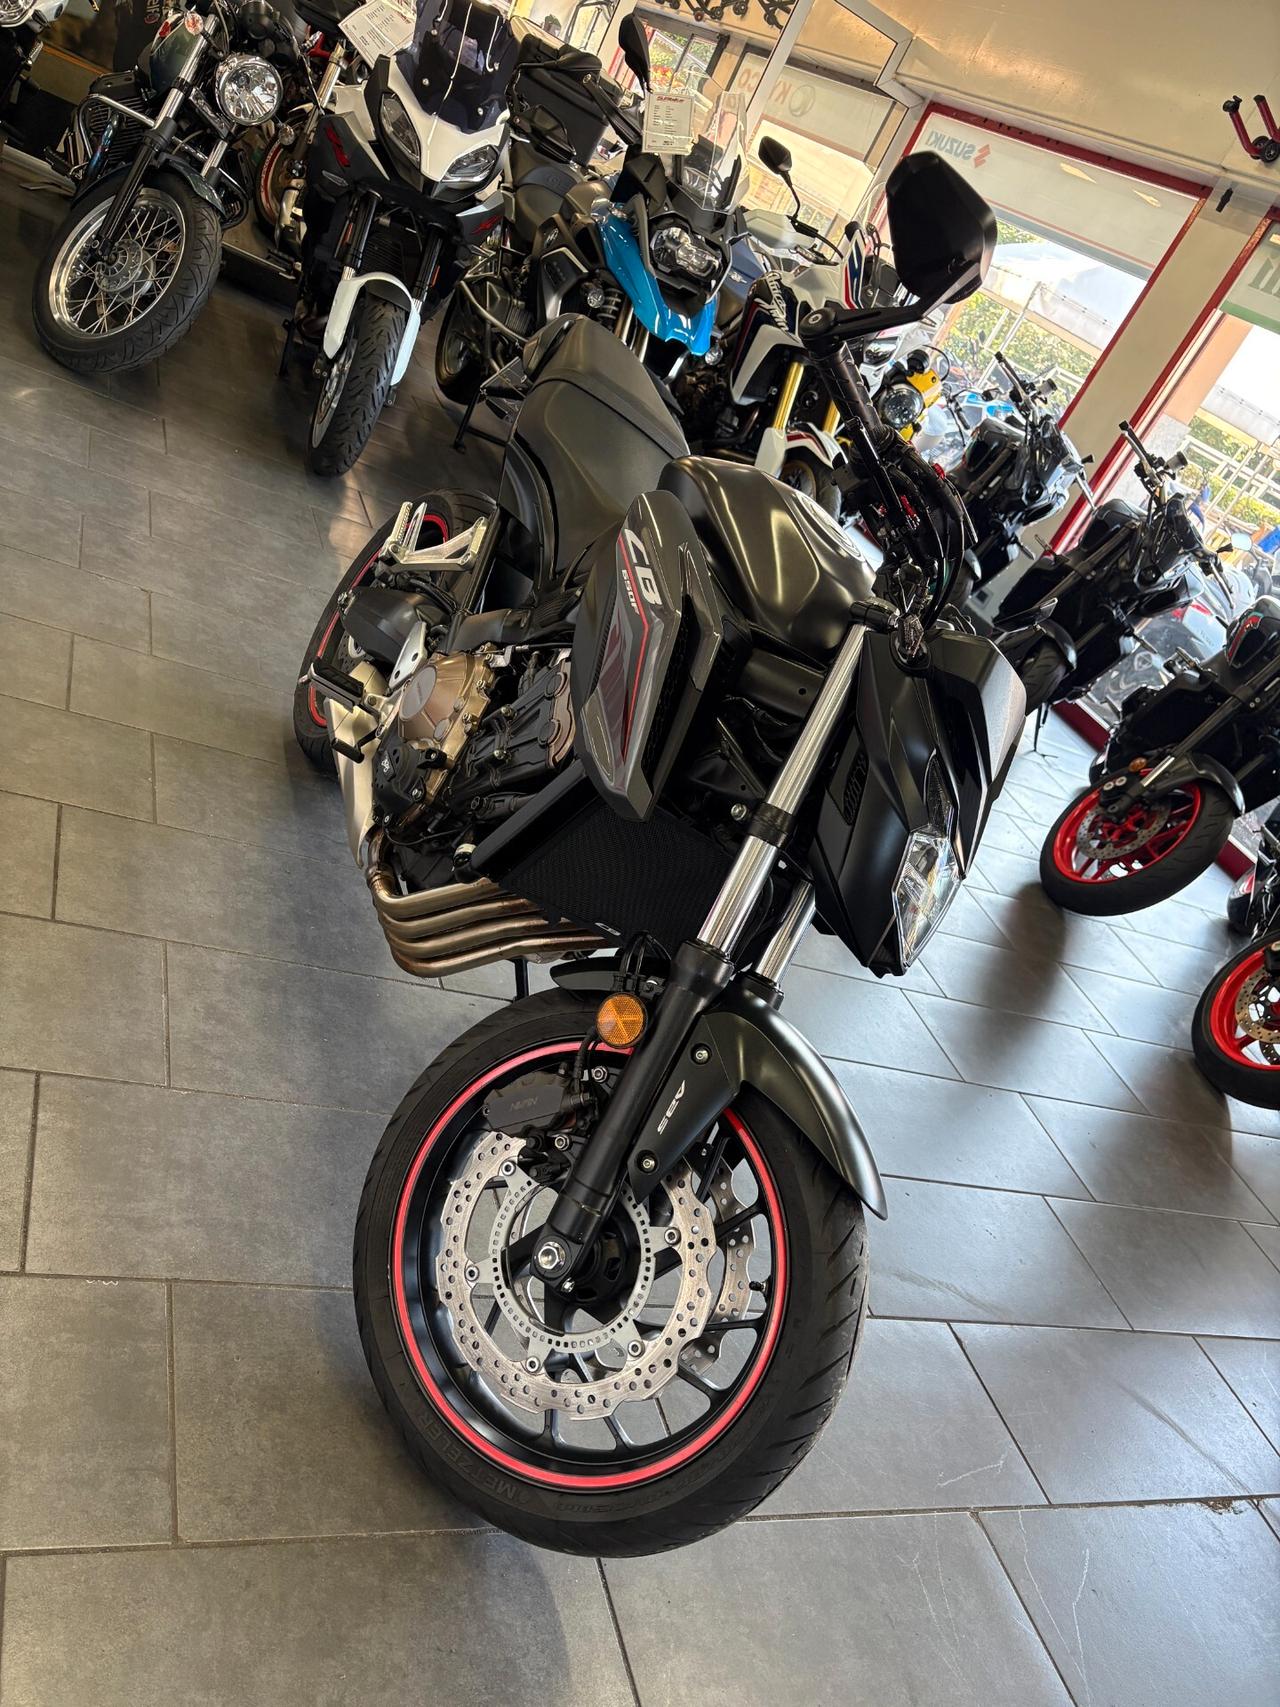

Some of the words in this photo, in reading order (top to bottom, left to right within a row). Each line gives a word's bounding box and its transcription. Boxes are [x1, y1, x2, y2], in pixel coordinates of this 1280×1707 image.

[624, 528, 663, 605] CB
[657, 1079, 685, 1135] ABS
[421, 1409, 518, 1500] METZELER
